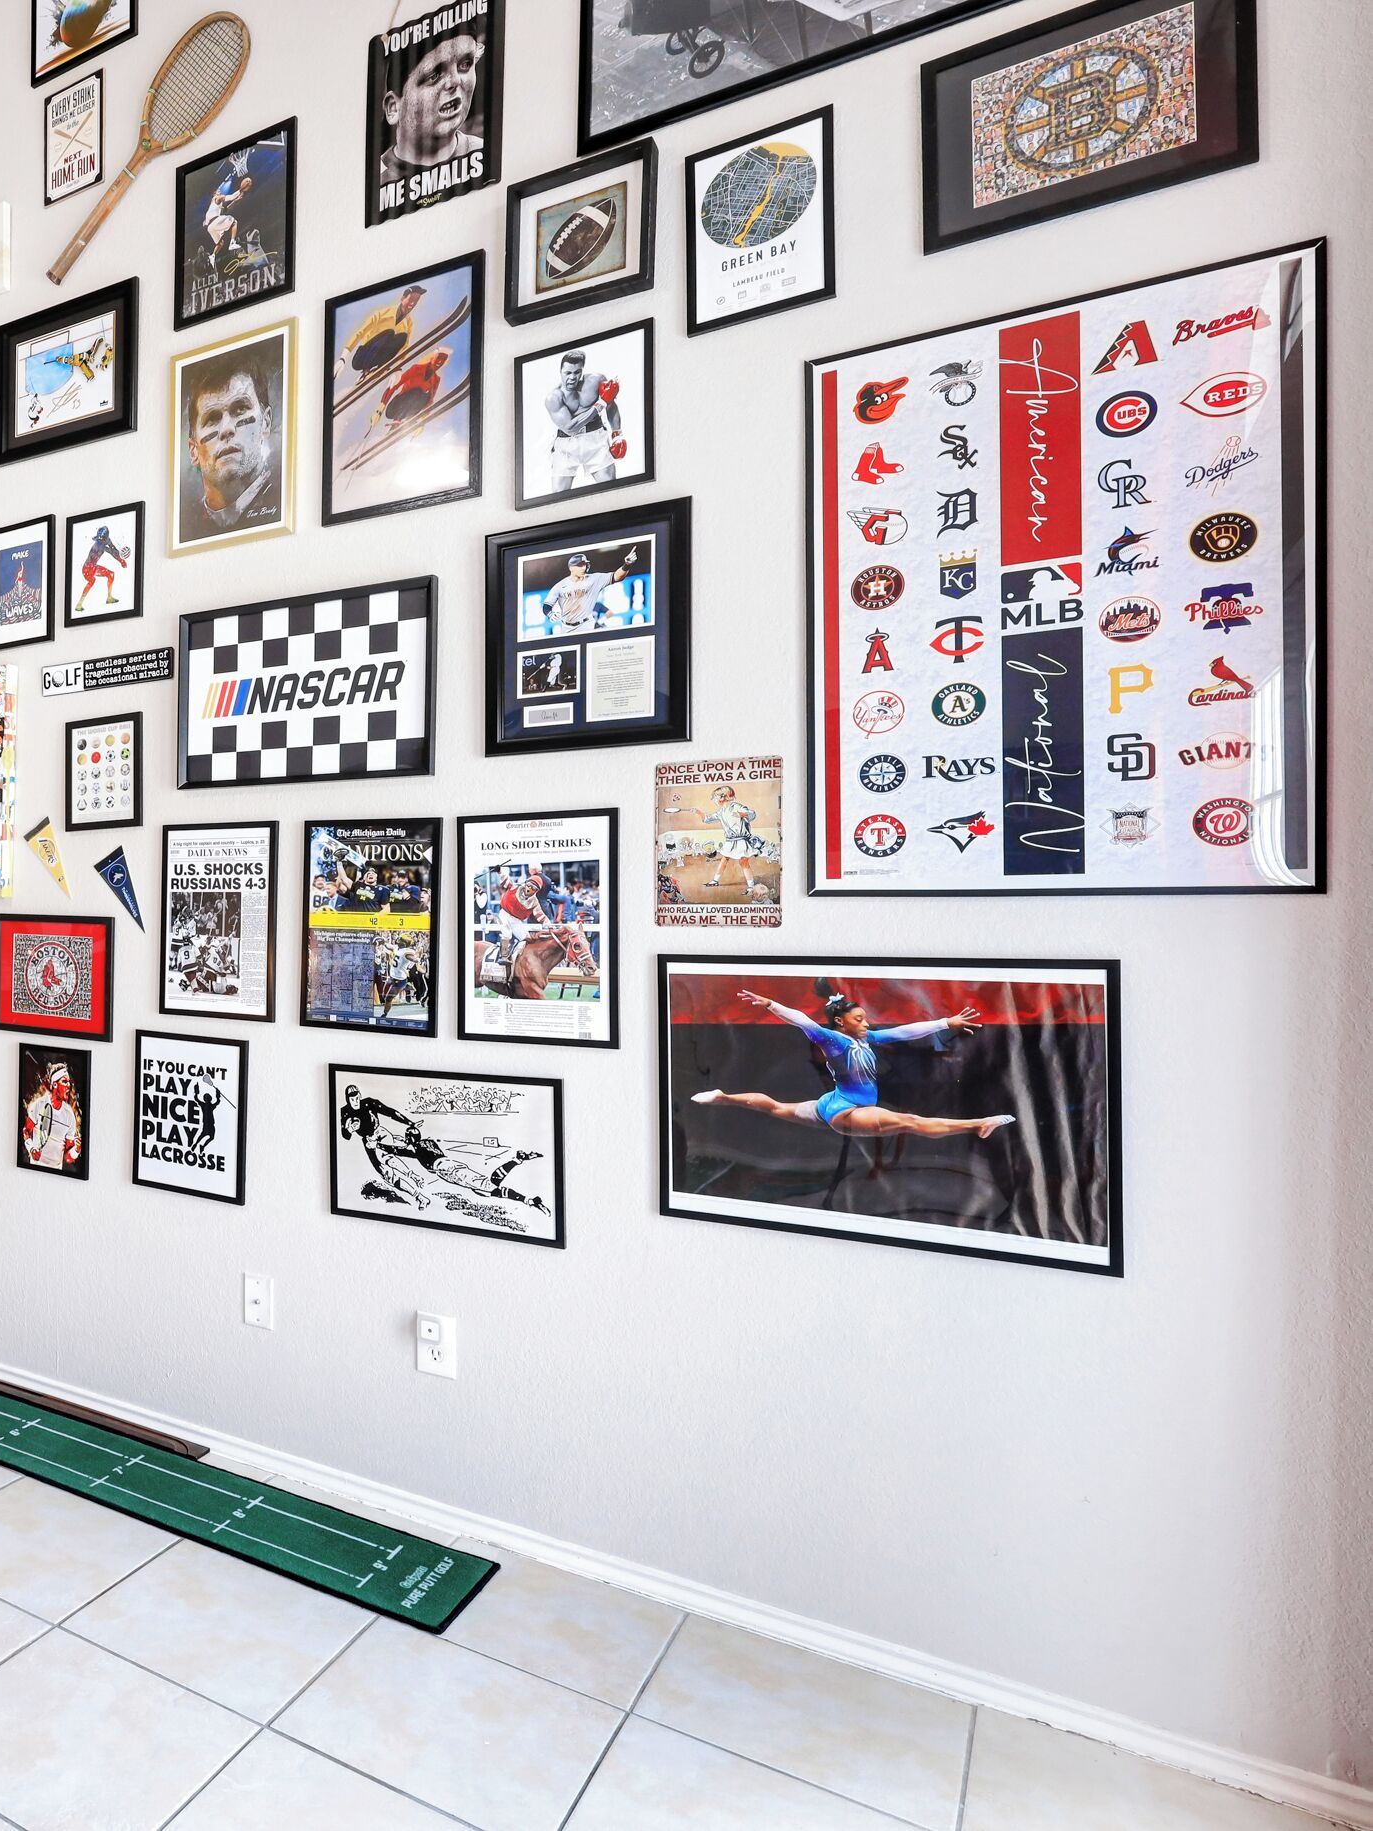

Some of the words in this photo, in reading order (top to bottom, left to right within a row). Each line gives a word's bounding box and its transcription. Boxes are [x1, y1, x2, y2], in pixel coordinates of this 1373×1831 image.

[382, 19, 429, 57] YOU'RE
[433, 0, 488, 36] KILLING
[52, 93, 71, 119] EVERY
[72, 84, 95, 106] STRIKE
[52, 113, 68, 128] BRINGS
[70, 110, 76, 119] ME
[77, 100, 95, 115] CLOSER
[64, 150, 82, 165] NEXT
[51, 165, 75, 190] HOME
[77, 152, 95, 178] RUN
[379, 179, 405, 212] ME
[409, 151, 484, 201] SMALLS
[721, 251, 764, 272] GREEN
[771, 240, 797, 257] BAY
[192, 272, 219, 292] ALLEN
[732, 274, 764, 287] LAMBEAU
[766, 267, 786, 281] FIELD
[190, 264, 276, 314] IVERSON
[1173, 306, 1254, 346] Braves
[1206, 381, 1263, 403] REDS
[999, 338, 1078, 543] American
[1185, 447, 1258, 487] Dodgers
[1196, 515, 1251, 536] MILWAUKEE
[12, 549, 30, 561] MAKE
[1200, 543, 1248, 560] BREWERS
[858, 568, 897, 583] HOUSTON
[1094, 556, 1159, 578] Miami
[943, 570, 974, 590] KC
[6, 603, 34, 616] WAVES
[860, 594, 896, 608] ASTROS
[1001, 598, 1084, 630] MLB
[1184, 600, 1264, 622] Phillies
[1108, 613, 1151, 631] Mets
[96, 657, 126, 668] endless
[129, 652, 156, 664] series
[158, 650, 169, 659] of
[522, 655, 537, 667] tel
[85, 666, 122, 679] tragedies
[123, 660, 158, 673] obscured
[159, 660, 169, 668] by
[85, 679, 96, 687] the
[98, 672, 137, 685] occasional
[139, 668, 169, 679] miracle
[247, 660, 406, 715] NASCAR
[938, 684, 978, 698] OAKLAND
[1108, 663, 1154, 714] P
[854, 706, 904, 726] Yankees
[938, 710, 980, 725] ATHLETICS
[864, 756, 902, 772] SEATTLE
[1107, 733, 1156, 781] SD
[659, 764, 694, 775] ONCE
[698, 761, 734, 772] UPON
[737, 761, 746, 770] A
[749, 759, 782, 769] TIME
[658, 774, 701, 785] THERE
[704, 772, 733, 782] WAS
[736, 772, 746, 780] A
[749, 770, 781, 780] GIRL
[863, 775, 903, 792] MARINERS
[538, 820, 563, 828] Journal
[862, 816, 899, 828] TEXAS
[1210, 810, 1241, 834] W
[337, 829, 351, 837] The
[351, 828, 384, 837] Michigan
[386, 828, 406, 837] Daily
[871, 828, 890, 846] T
[187, 849, 214, 857] DAILY
[222, 848, 248, 856] NEWS
[481, 841, 509, 850] LONG
[512, 840, 541, 849] SHOT
[544, 838, 592, 848] STRIKES
[857, 838, 903, 856] RANGERS
[174, 864, 199, 875] U.S.
[204, 863, 263, 875] SHOCKS
[171, 878, 241, 890] RUSSIANS
[246, 878, 266, 889] 4-3
[658, 915, 667, 924] IT
[670, 915, 696, 924] WAS
[699, 915, 720, 924] ME.
[722, 915, 747, 924] THE
[734, 906, 782, 914] BADMINTON
[31, 947, 73, 967] BOSTON
[143, 1059, 154, 1071] IF
[157, 1060, 184, 1075] YOU
[188, 1065, 227, 1080] CAN'T
[143, 1073, 192, 1096] PLAY
[142, 1094, 200, 1124] NICE
[142, 1120, 199, 1148] PLAY
[142, 1143, 225, 1172] LACROSSE
[233, 1507, 245, 1518] 8'
[374, 1559, 385, 1572] 9'
[401, 1588, 426, 1609] PURE
[418, 1571, 442, 1591] PUTT
[434, 1556, 455, 1574] GOLF
